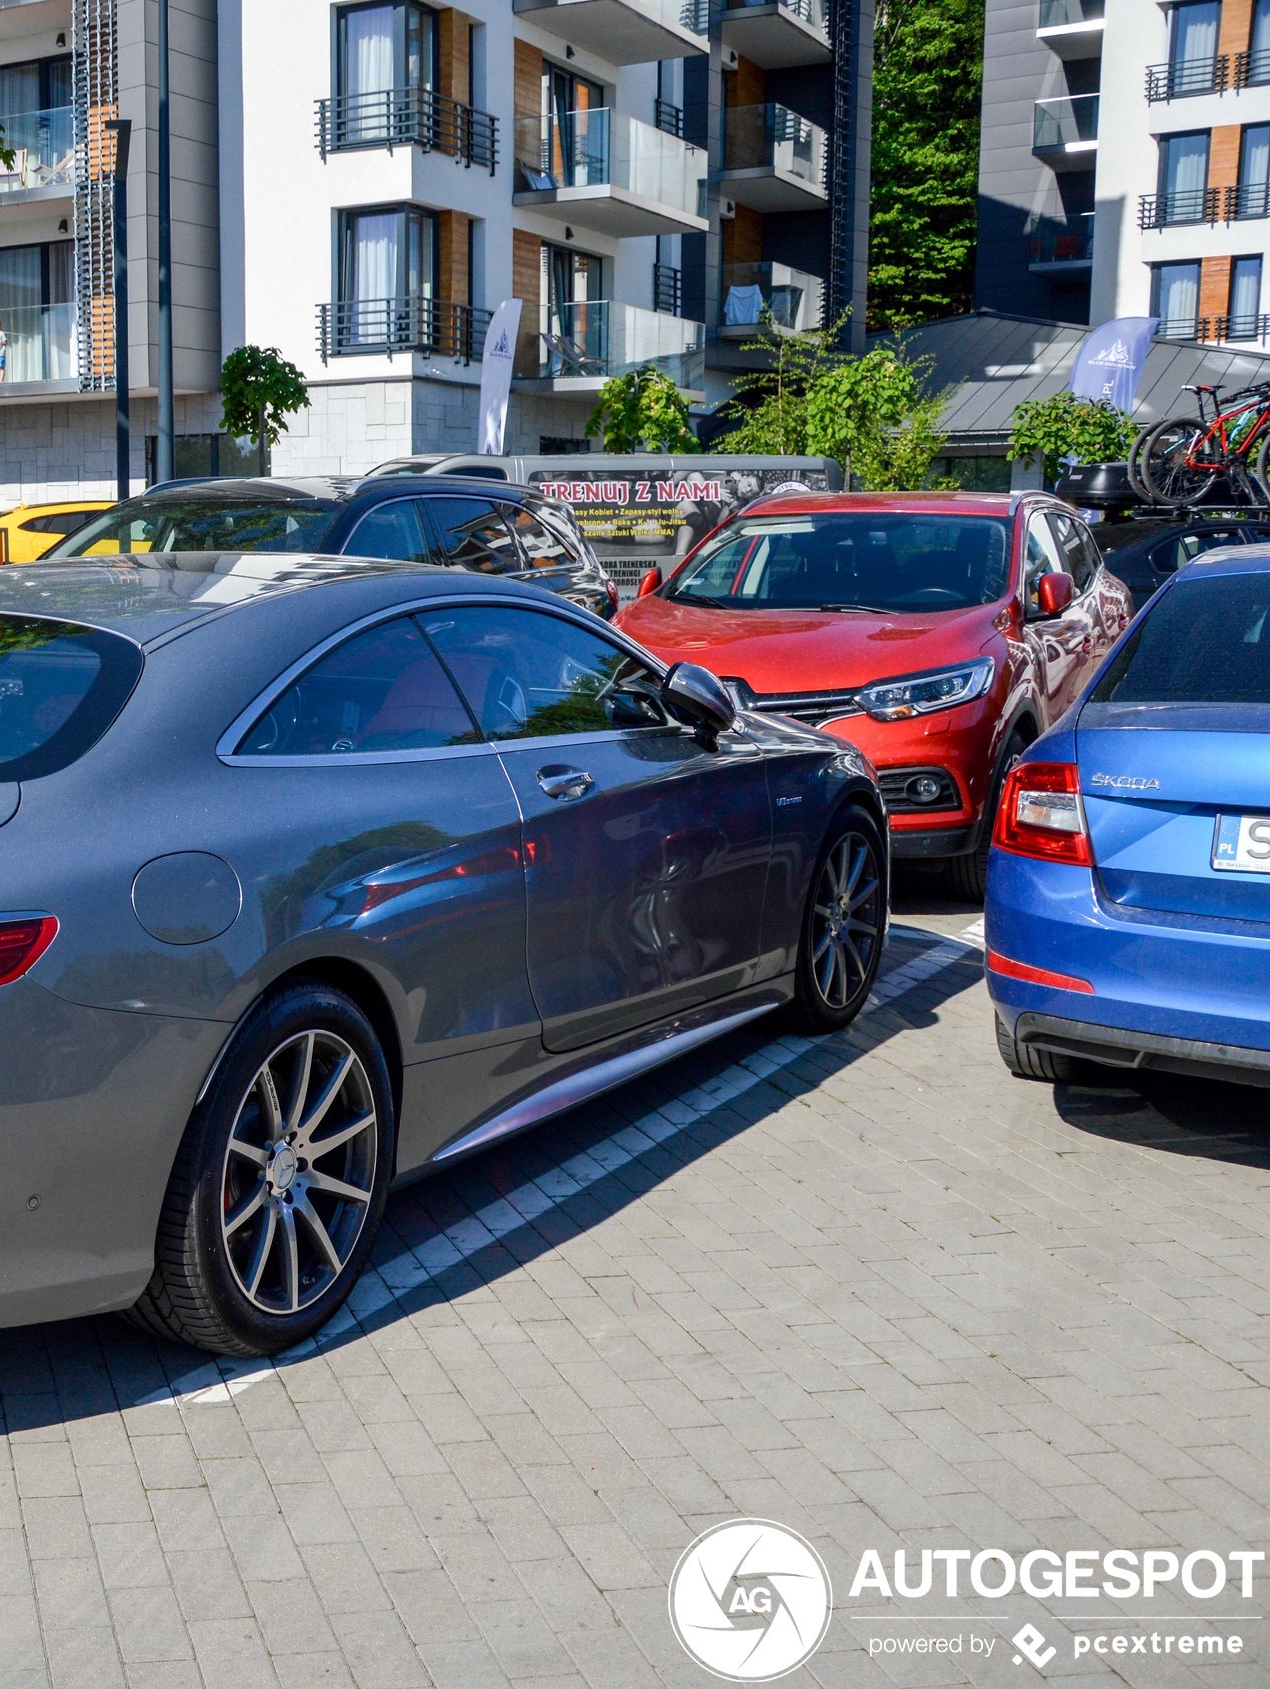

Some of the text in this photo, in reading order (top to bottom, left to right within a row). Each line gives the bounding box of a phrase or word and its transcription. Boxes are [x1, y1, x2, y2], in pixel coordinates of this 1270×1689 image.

[1104, 361, 1136, 370] MOUNTAIN
[1102, 379, 1115, 398] .PL
[540, 480, 721, 506] TRENUJ Z NAMI
[574, 508, 684, 517] asy Kobiet Zapasy styl wolny
[613, 518, 631, 526] Boks
[657, 518, 687, 526] Ju-Jitsu
[607, 528, 629, 537] Sztuki
[599, 560, 657, 569] ADRA TRENERSKA
[610, 569, 641, 578] TRENINGI
[1091, 772, 1161, 790] ŠKODA
[1219, 843, 1235, 855] PL
